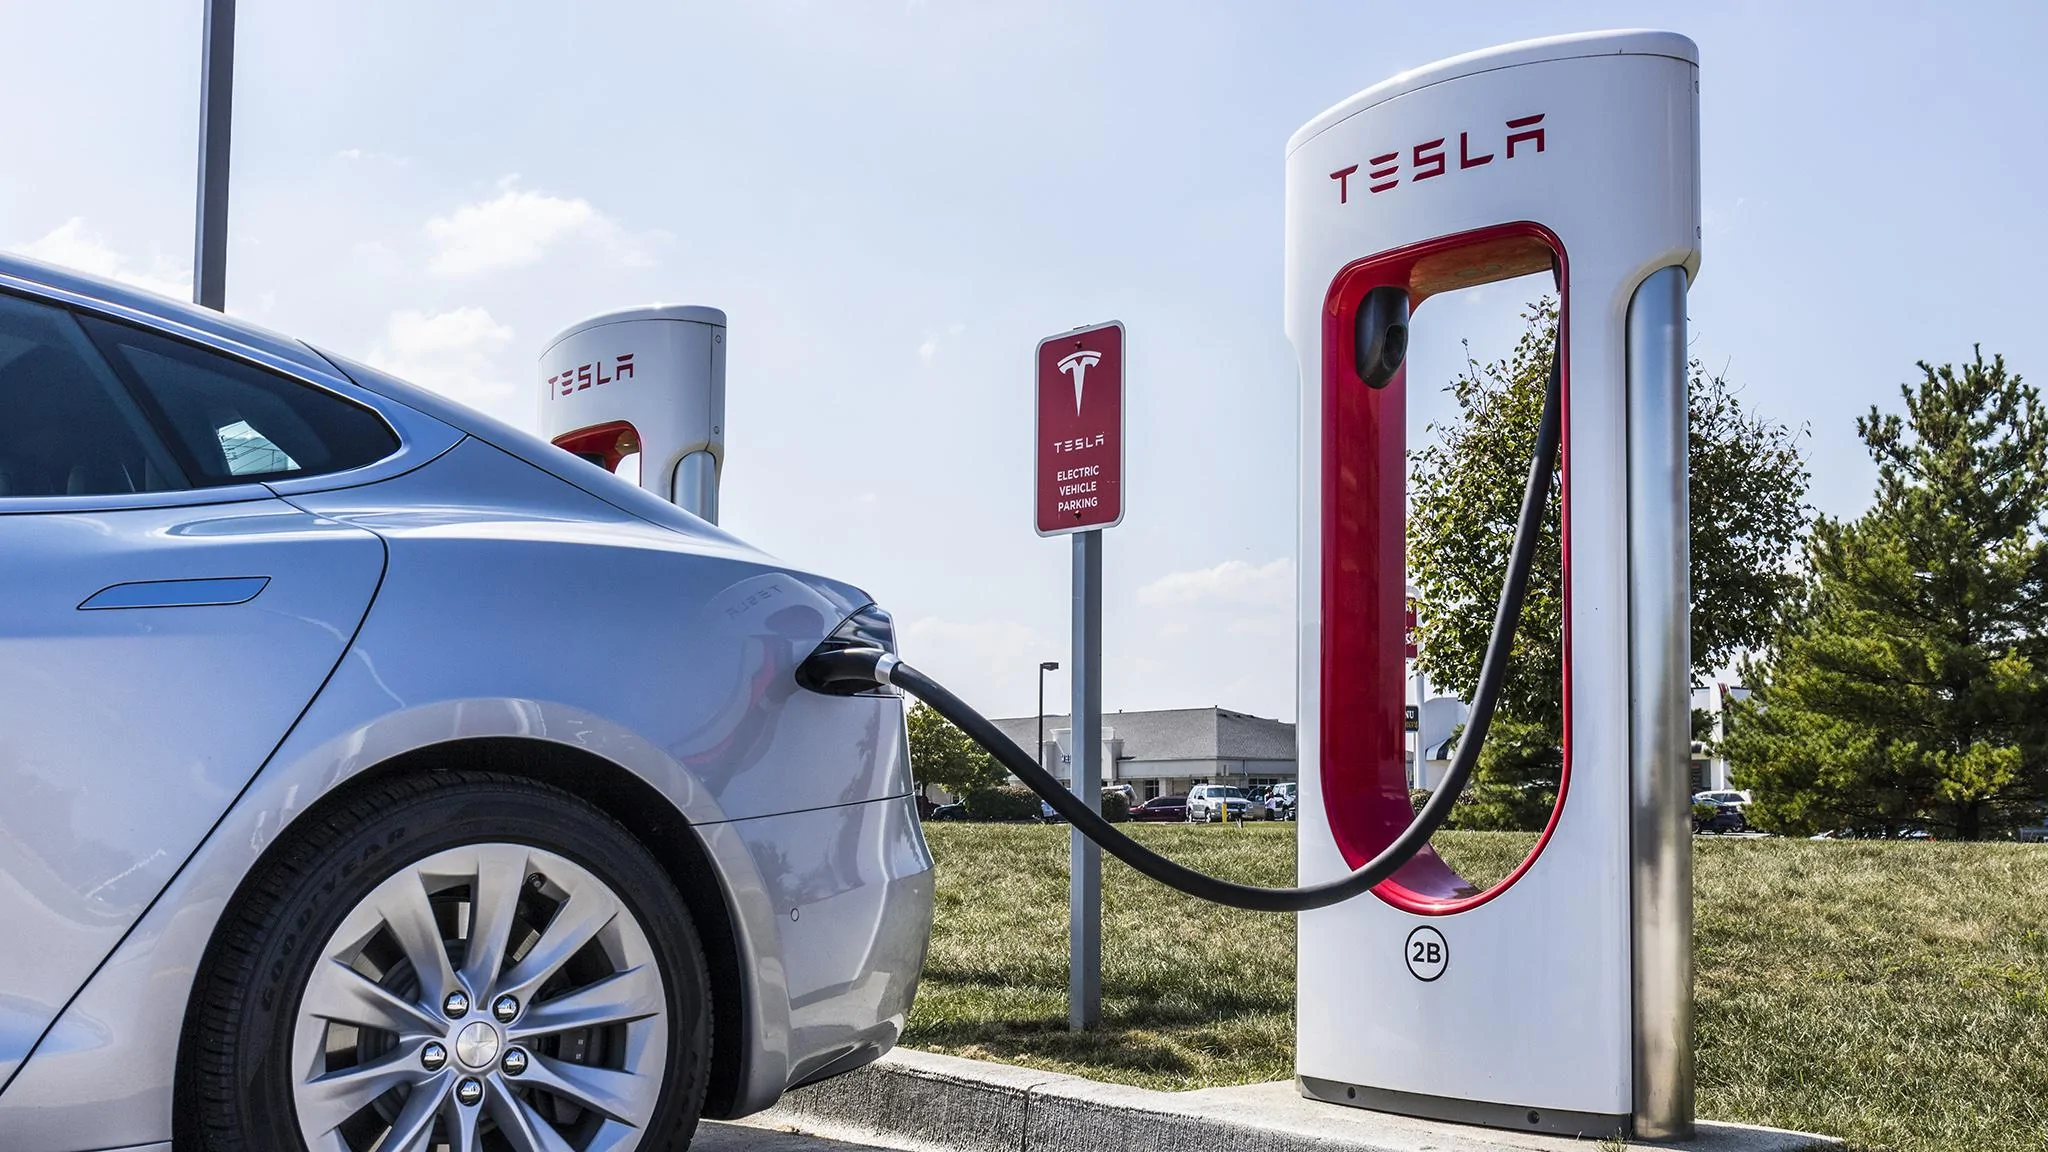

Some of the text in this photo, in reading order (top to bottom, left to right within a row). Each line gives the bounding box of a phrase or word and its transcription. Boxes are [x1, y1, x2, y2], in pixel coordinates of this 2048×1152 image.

[1329, 112, 1546, 205] TESLA
[547, 353, 634, 401] TESLA
[1053, 434, 1104, 454] TESLA
[1057, 465, 1100, 482] ELECTRIC
[1059, 481, 1097, 497] VEHICLE
[1058, 497, 1098, 512] PARKING
[261, 826, 406, 1012] GOODYEAR
[1412, 941, 1442, 964] 2B
